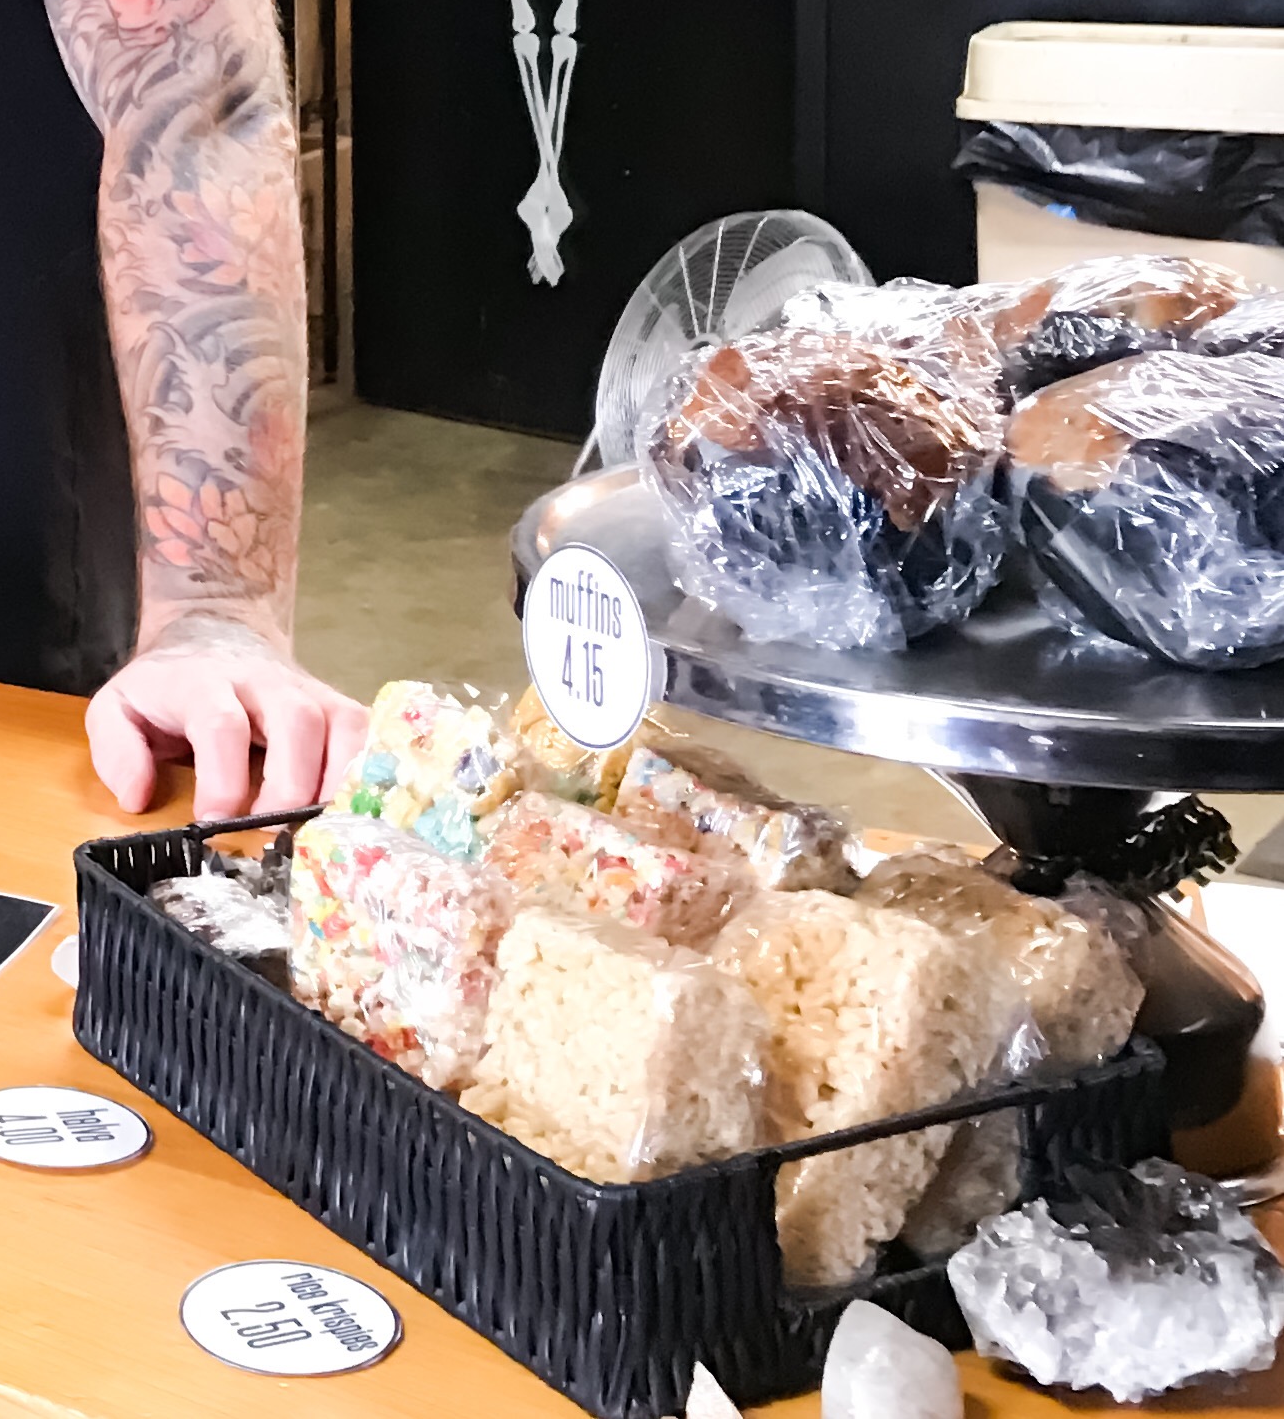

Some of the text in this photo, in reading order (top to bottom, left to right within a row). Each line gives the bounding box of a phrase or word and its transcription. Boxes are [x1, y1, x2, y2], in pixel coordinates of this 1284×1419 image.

[550, 570, 622, 639] muffins
[562, 635, 604, 707] 4.15
[220, 1300, 312, 1351] 2.50
[280, 1272, 379, 1353] rice krispies
